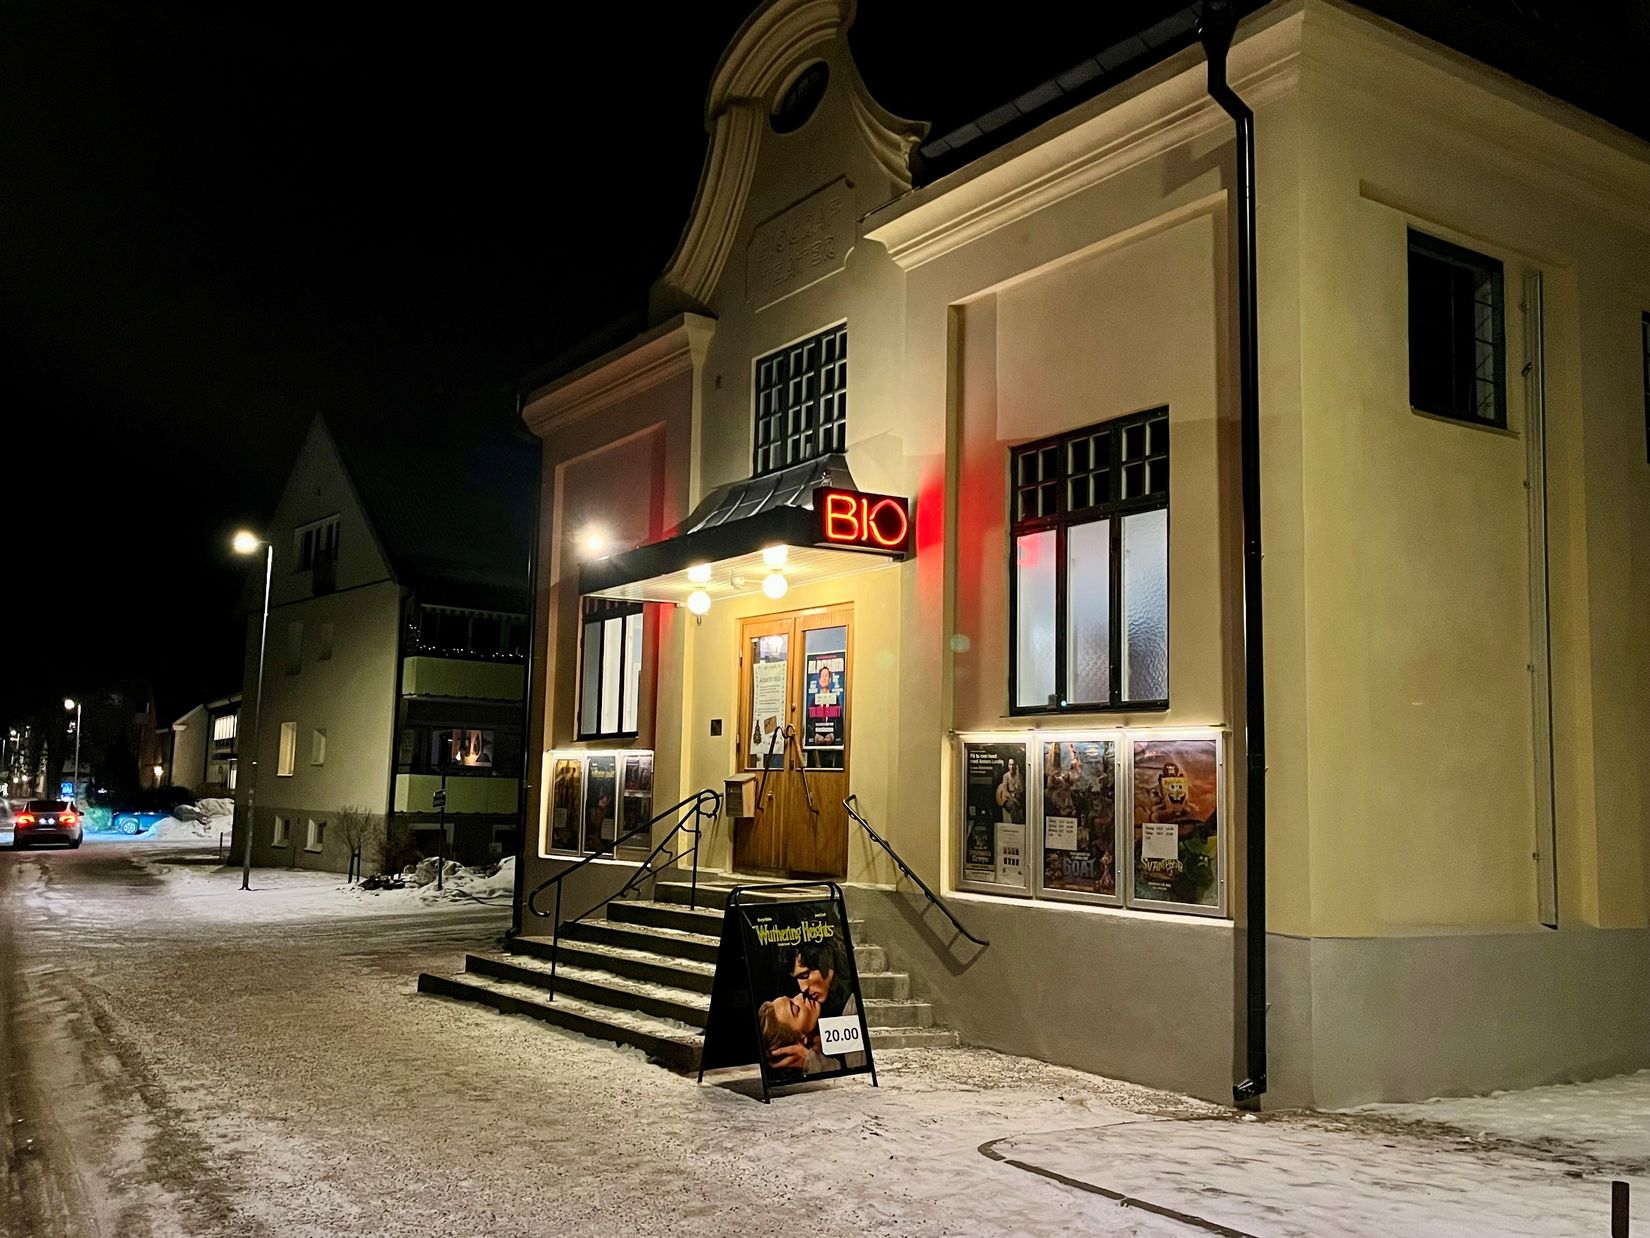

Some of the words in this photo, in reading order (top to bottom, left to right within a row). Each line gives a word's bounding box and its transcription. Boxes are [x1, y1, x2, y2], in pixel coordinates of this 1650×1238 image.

[761, 234, 837, 291] TEATER
[826, 494, 907, 545] BIO
[1062, 857, 1097, 878] GOAT
[752, 924, 802, 946] Wuthering
[801, 921, 835, 944] Heights
[824, 1027, 859, 1043] 20.00
